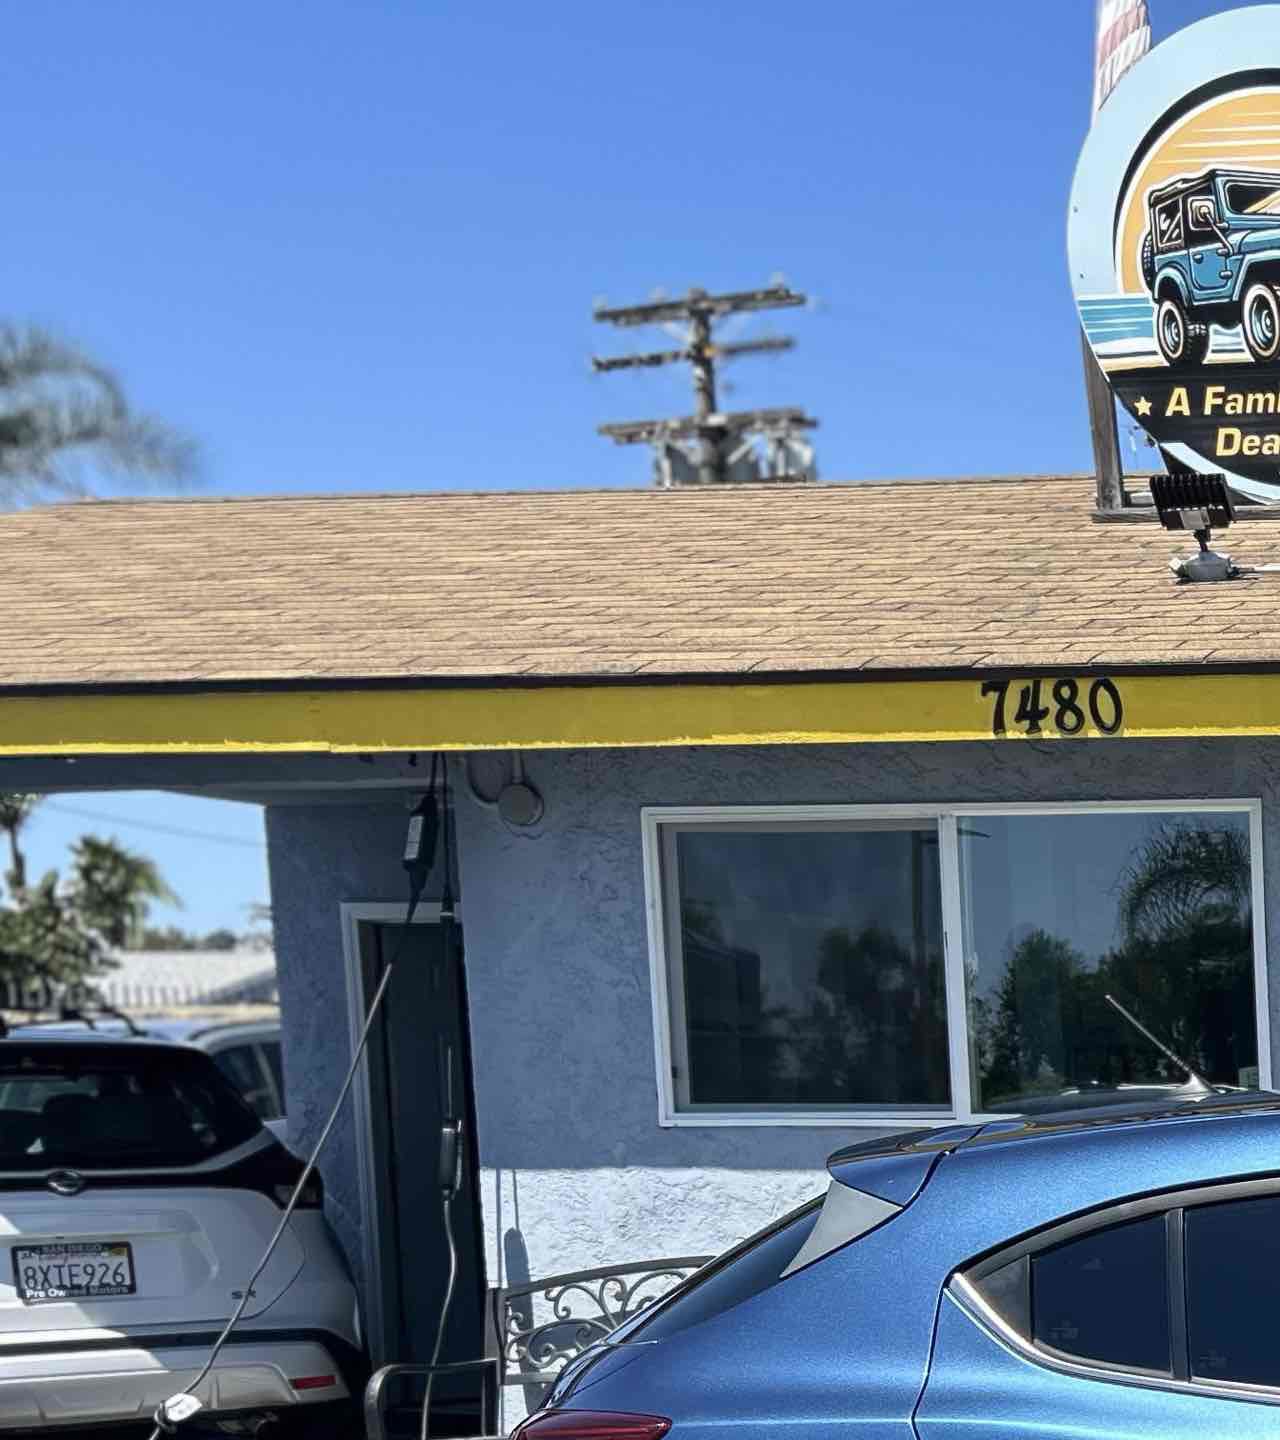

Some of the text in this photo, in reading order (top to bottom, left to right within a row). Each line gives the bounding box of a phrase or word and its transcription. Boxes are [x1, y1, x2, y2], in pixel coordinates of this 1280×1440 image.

[1165, 388, 1191, 416] A
[980, 677, 1123, 735] 7480
[26, 1289, 46, 1298] Pre
